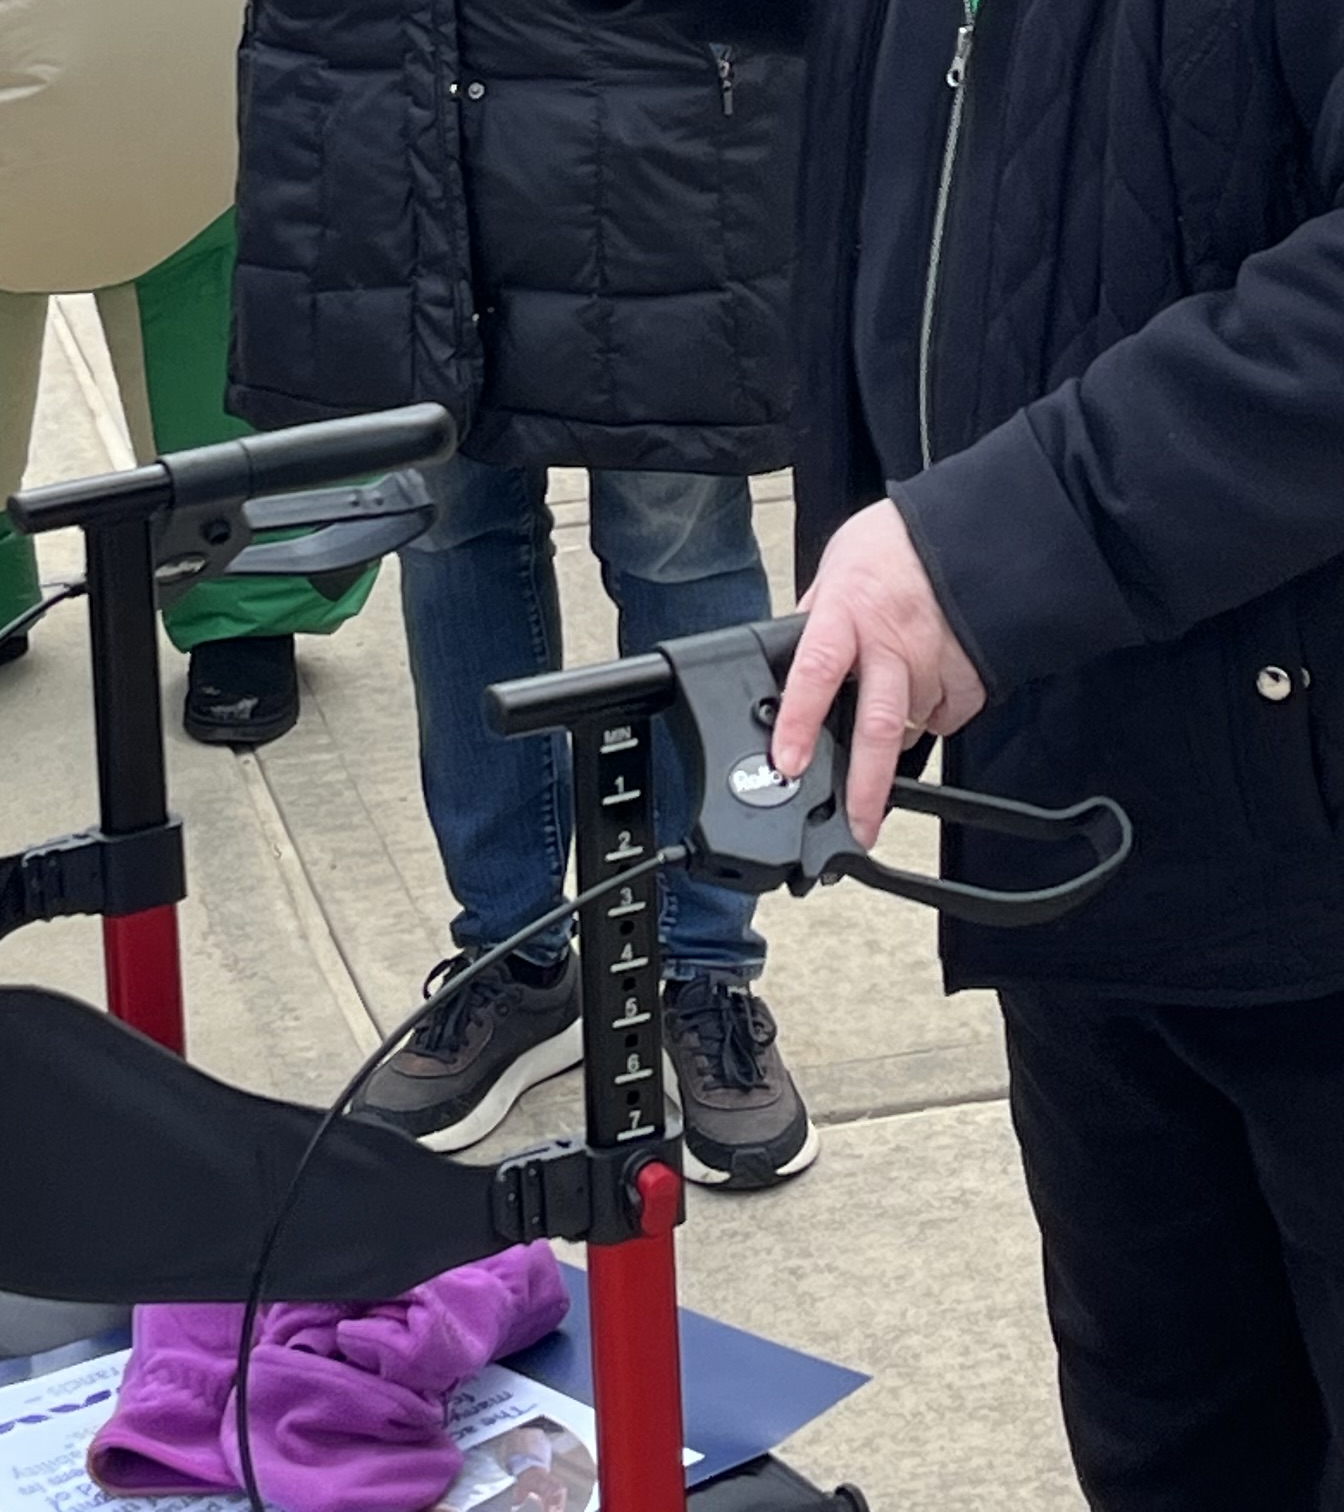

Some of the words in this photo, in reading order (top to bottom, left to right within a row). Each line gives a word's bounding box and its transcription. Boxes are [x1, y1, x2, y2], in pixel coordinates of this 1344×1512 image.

[604, 725, 633, 742] MIN
[614, 776, 625, 794] 1
[617, 831, 632, 851] 2
[620, 887, 633, 905] 3
[620, 943, 633, 960] 4
[625, 998, 638, 1018] 5
[627, 1053, 640, 1073] 6
[628, 1109, 642, 1129] 7
